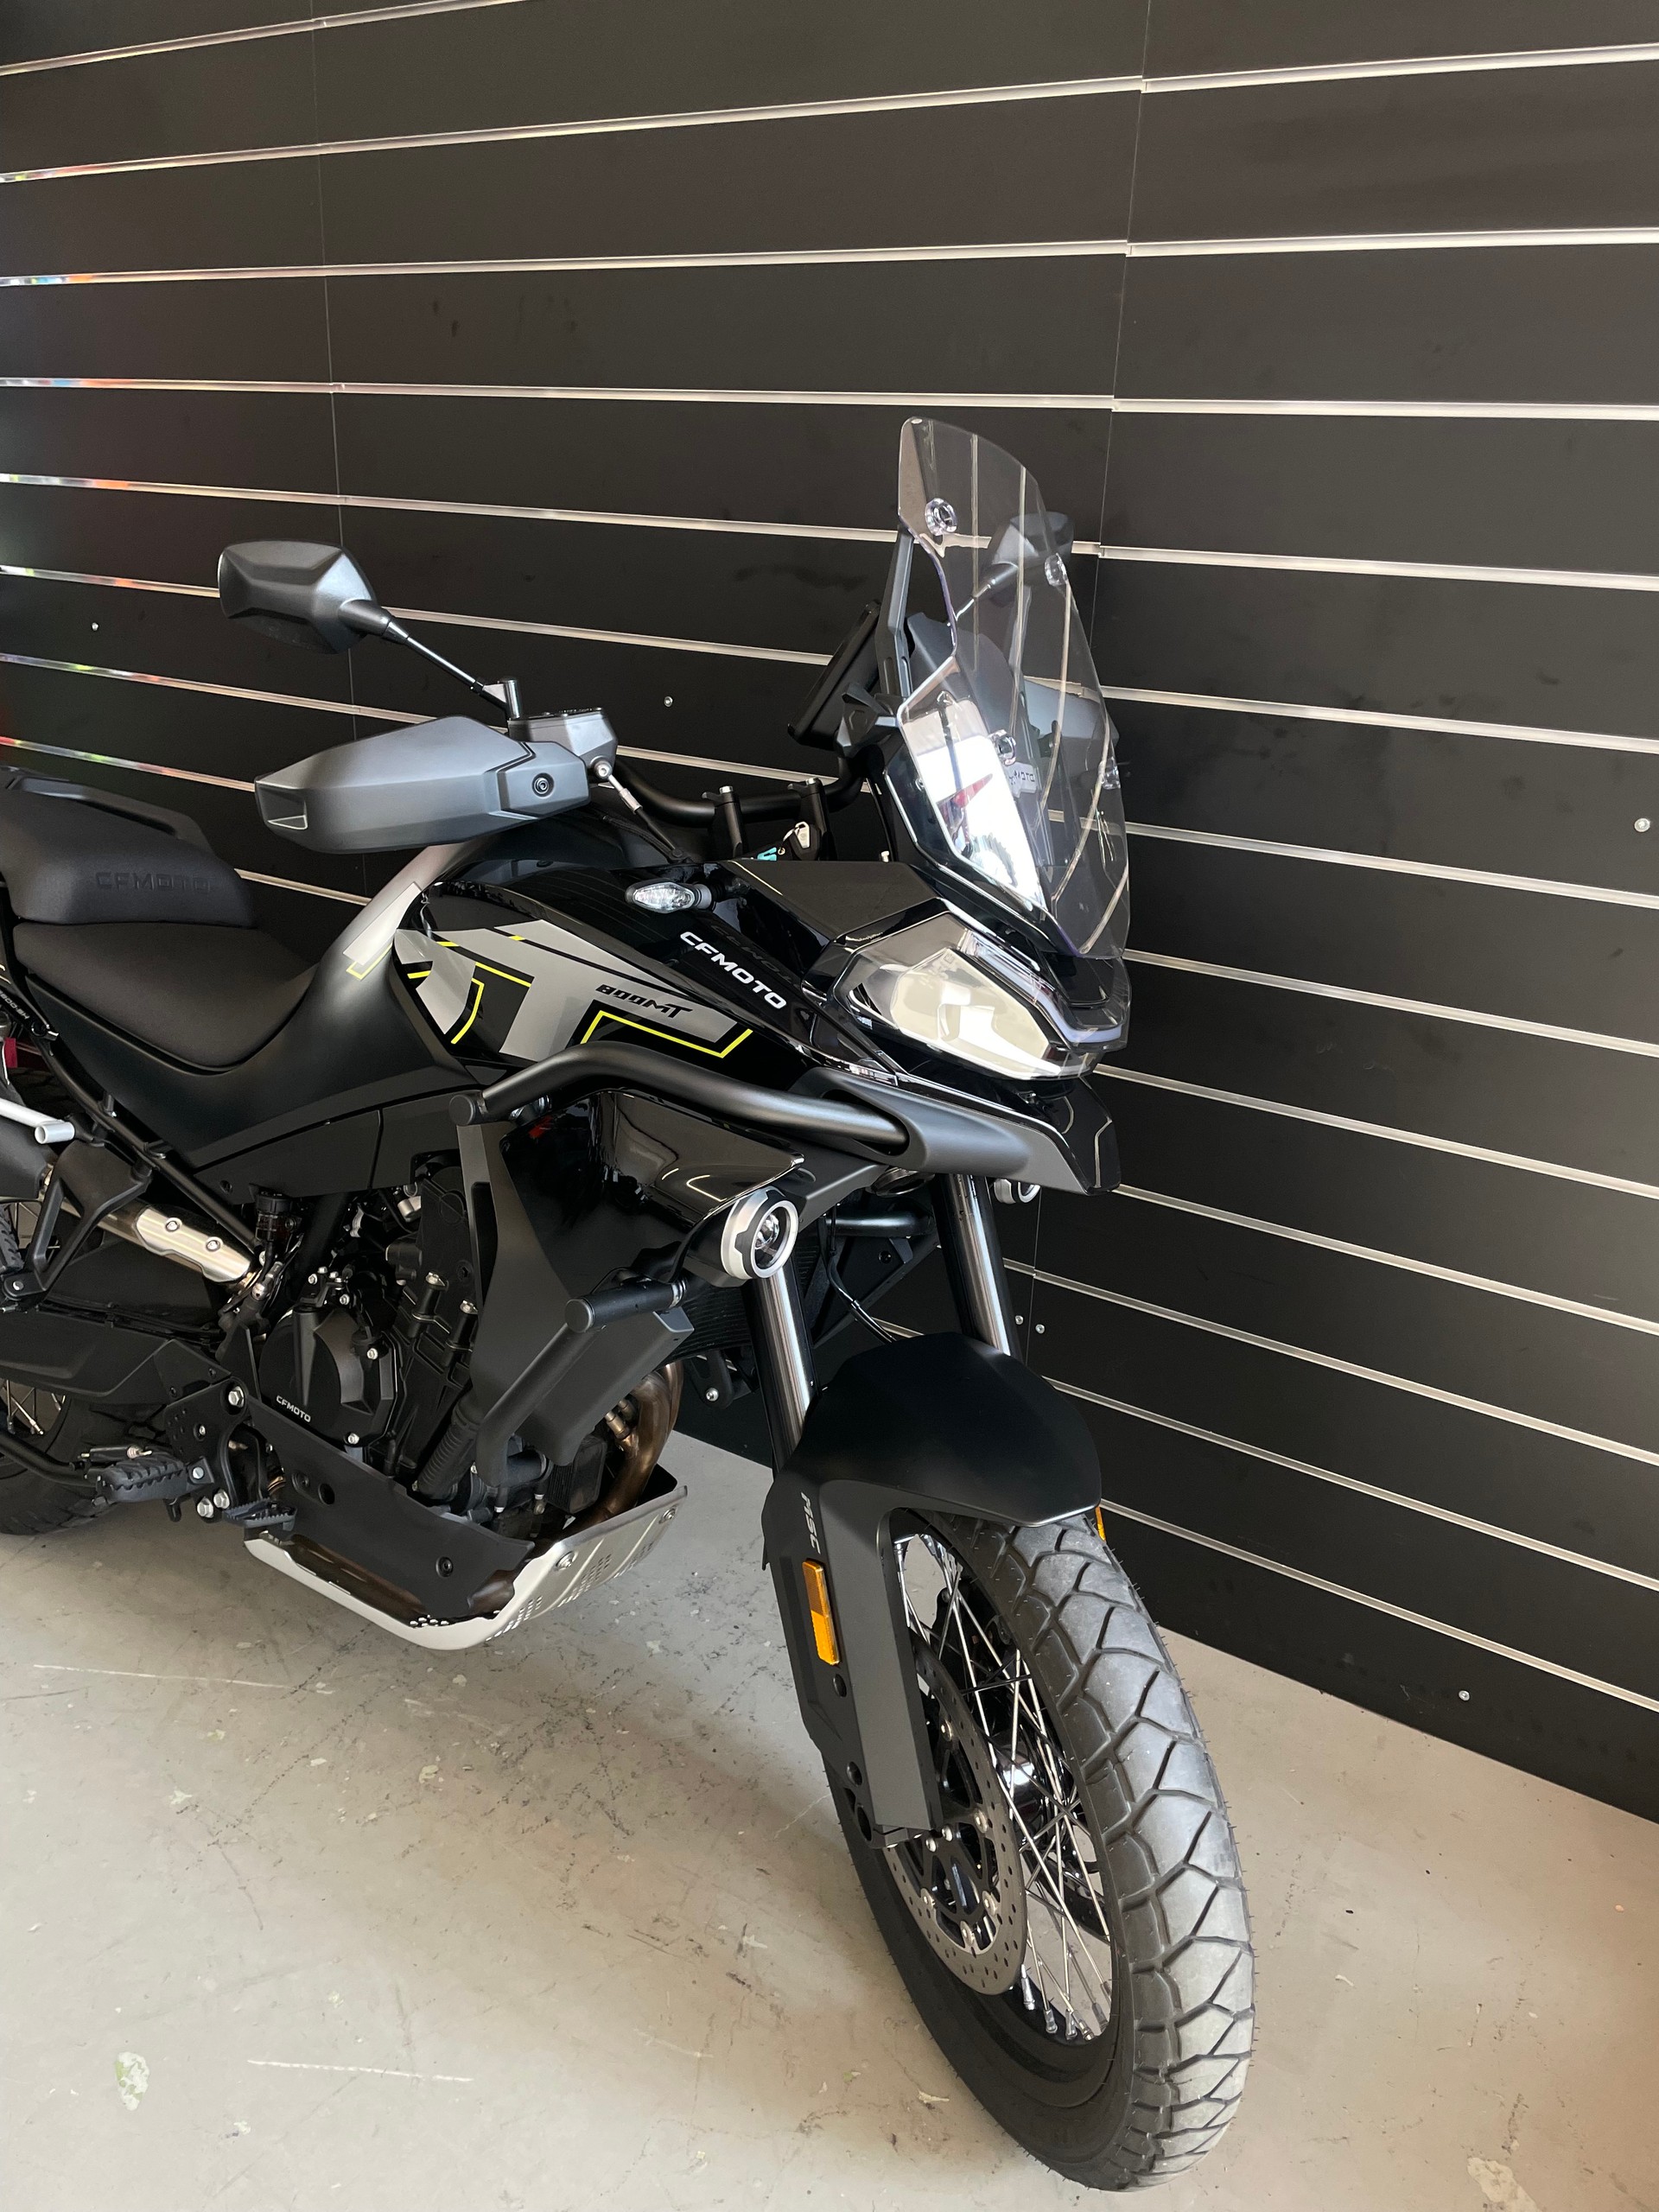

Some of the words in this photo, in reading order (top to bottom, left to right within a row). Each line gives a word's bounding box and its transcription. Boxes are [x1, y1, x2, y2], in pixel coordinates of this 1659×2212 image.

[96, 871, 211, 893] CFMOTO
[680, 931, 787, 1009] CFMOTO
[595, 984, 693, 1018] 800MT
[276, 1395, 311, 1423] CFMOTO
[800, 1491, 821, 1554] MSC
